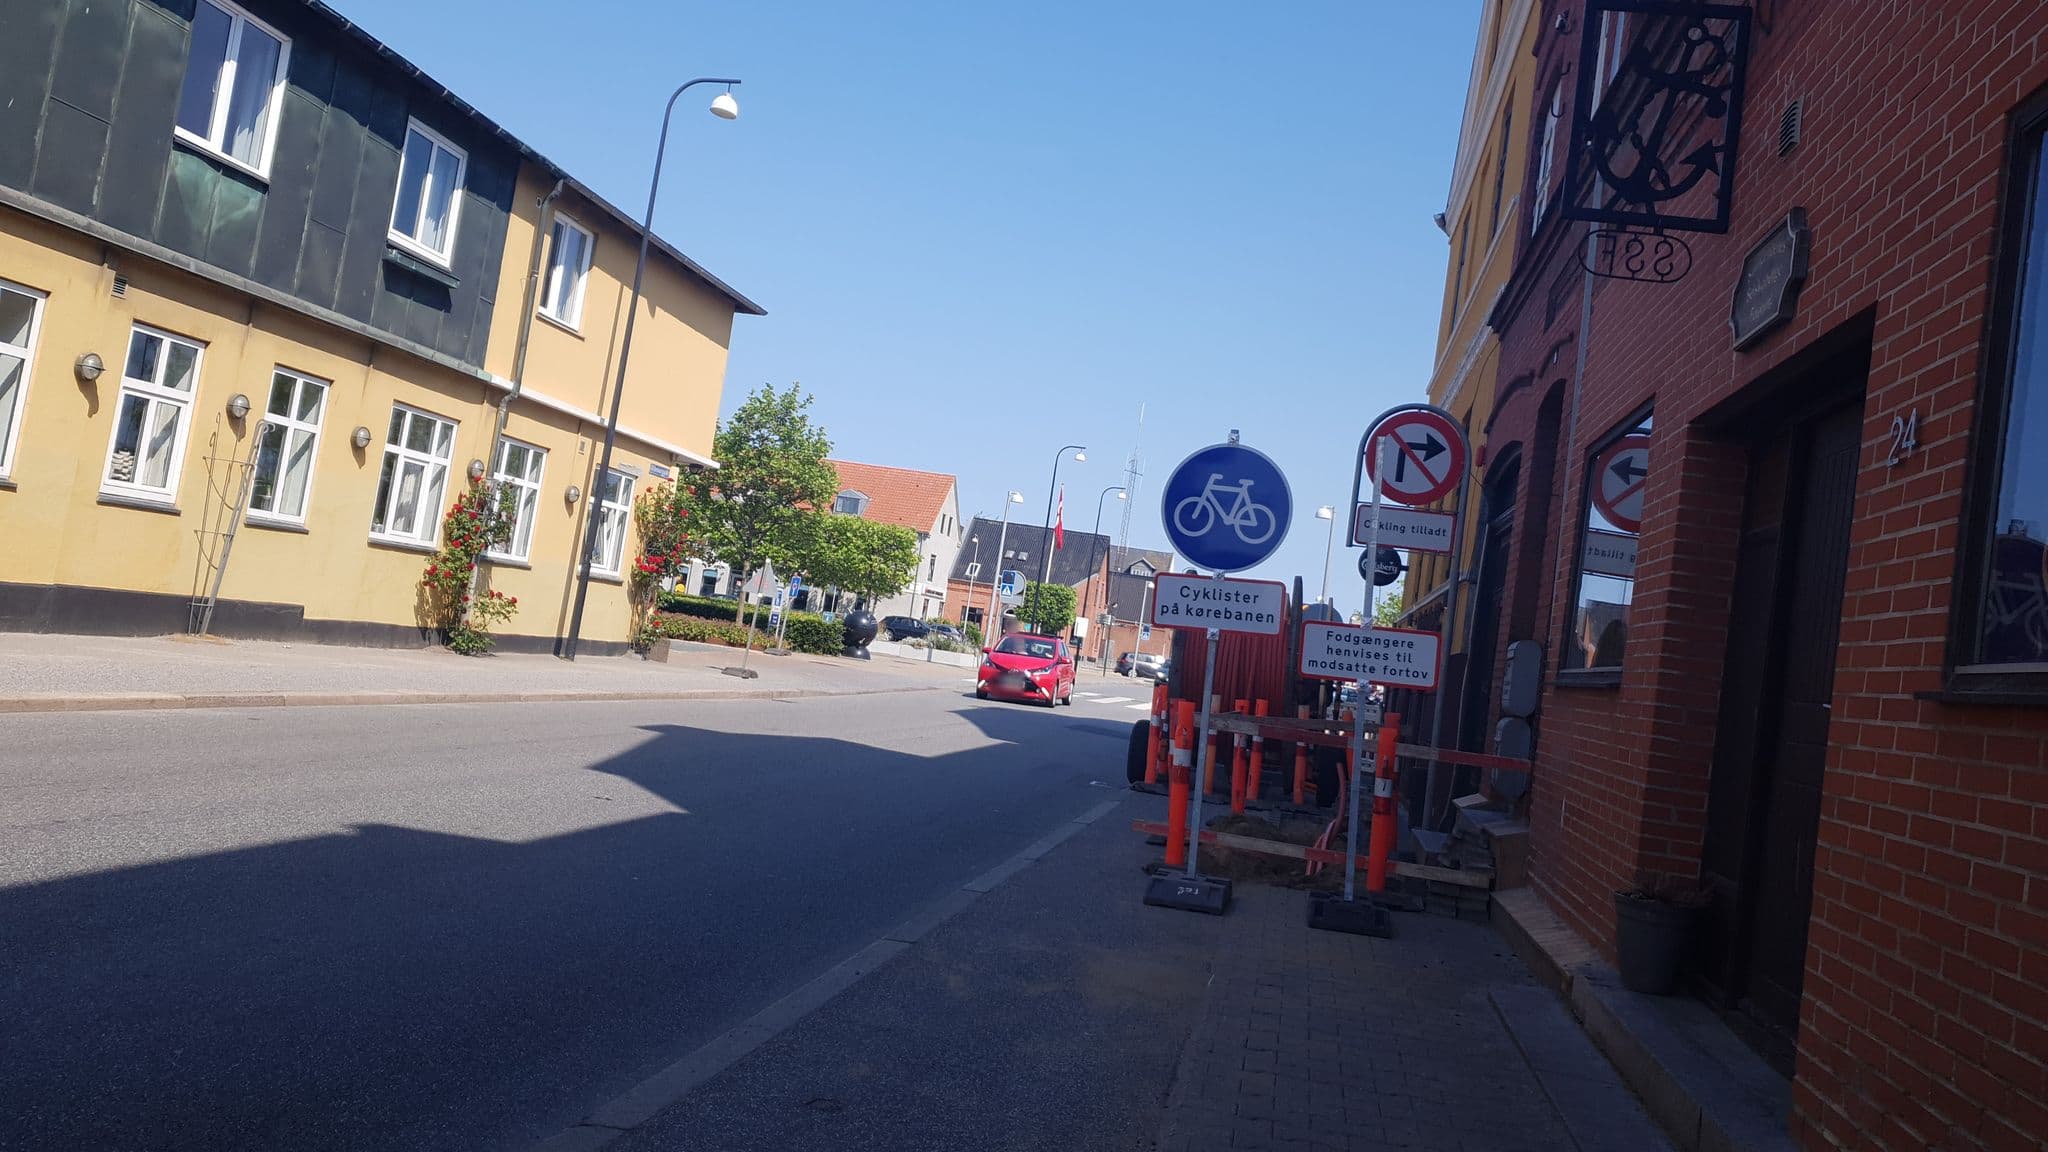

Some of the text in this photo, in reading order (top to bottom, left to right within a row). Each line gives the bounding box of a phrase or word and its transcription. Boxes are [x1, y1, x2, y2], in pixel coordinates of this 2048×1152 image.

[1887, 407, 1917, 466] 24
[1363, 519, 1447, 538] Ckling tilladt
[1180, 585, 1259, 603] Cyklister
[1160, 602, 1275, 624] på kørebanen
[1326, 630, 1415, 649] Fodgængere
[1326, 645, 1413, 664] henvises til
[1307, 659, 1429, 679] modsatte fortov
